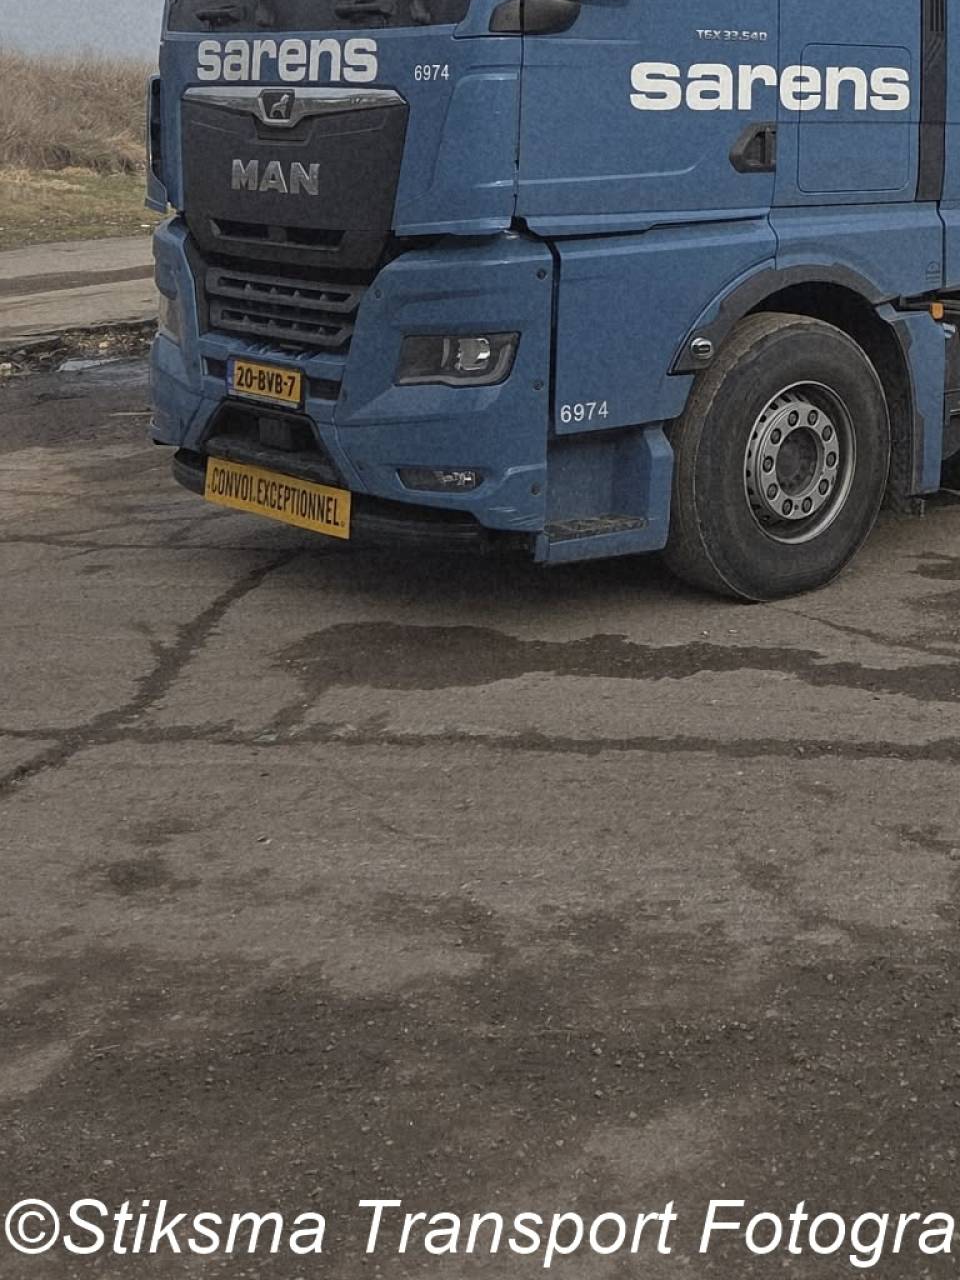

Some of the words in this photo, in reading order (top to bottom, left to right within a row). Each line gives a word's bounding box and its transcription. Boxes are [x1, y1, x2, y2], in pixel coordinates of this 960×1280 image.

[196, 37, 378, 83] sarens
[413, 63, 450, 81] 6974
[629, 61, 911, 111] sarens
[231, 158, 320, 196] MAN
[236, 365, 297, 397] 20-BVB-7
[560, 400, 609, 423] 6974
[210, 466, 254, 503] CONVOI
[256, 478, 340, 527] EXCEPTIONNEL
